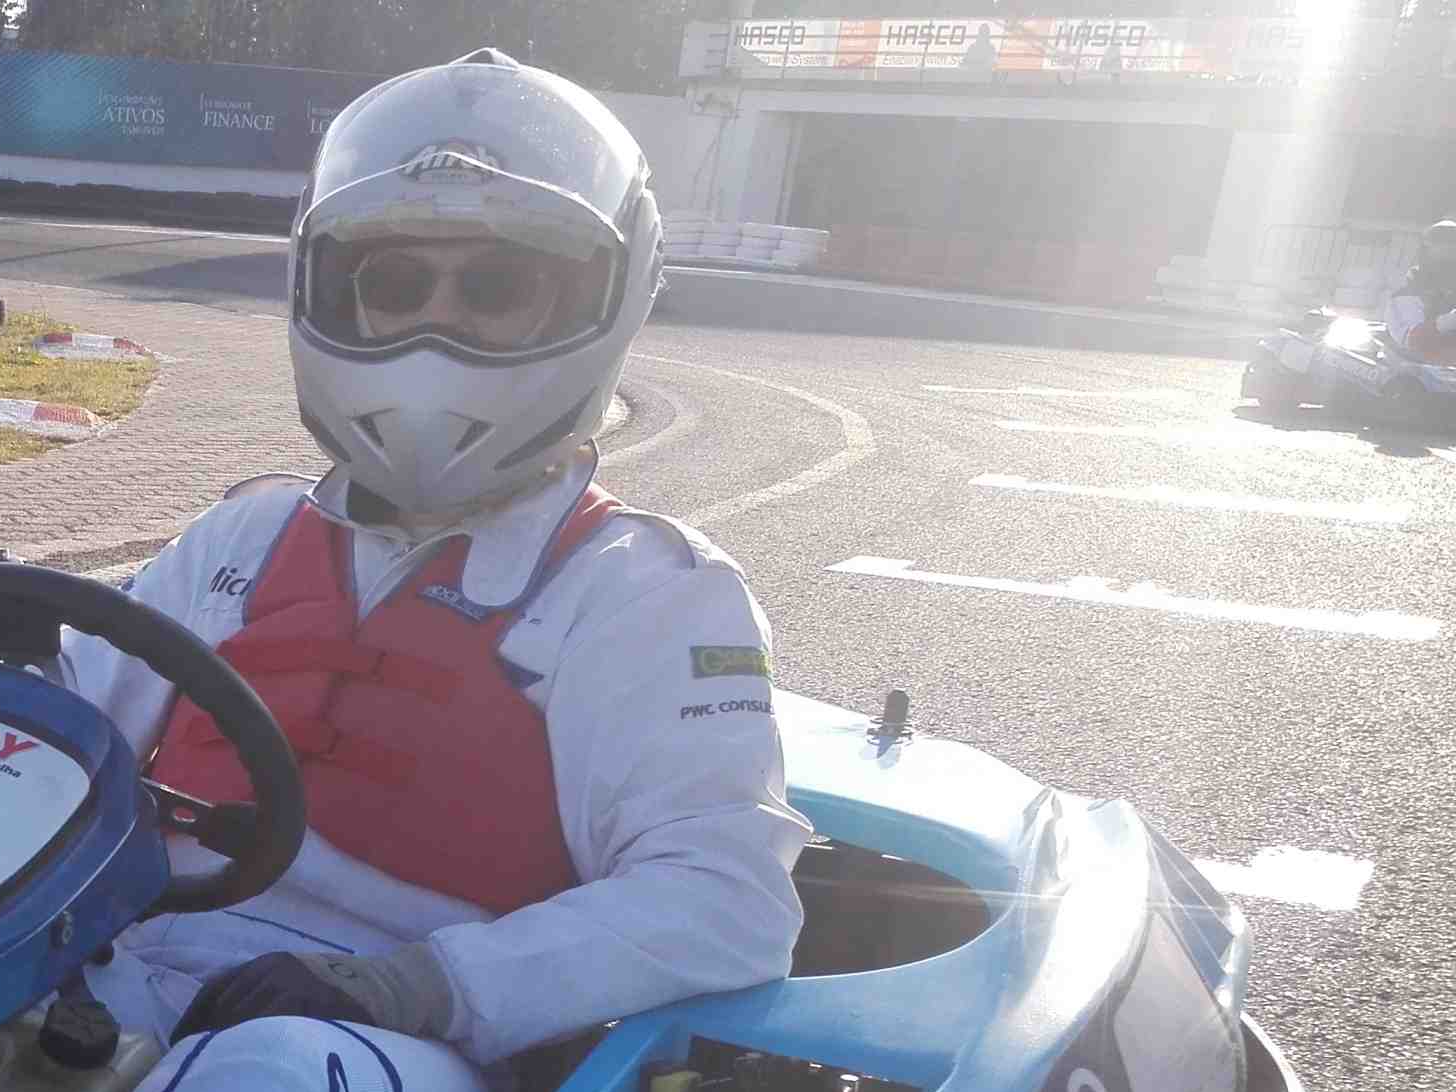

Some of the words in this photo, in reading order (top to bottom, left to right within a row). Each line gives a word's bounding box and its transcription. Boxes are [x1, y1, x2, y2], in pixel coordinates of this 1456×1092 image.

[734, 26, 806, 46] HASCO
[886, 25, 967, 46] HASCO
[1055, 24, 1147, 47] HASCO
[102, 107, 165, 125] ATIVOS
[202, 111, 275, 130] FINANCE
